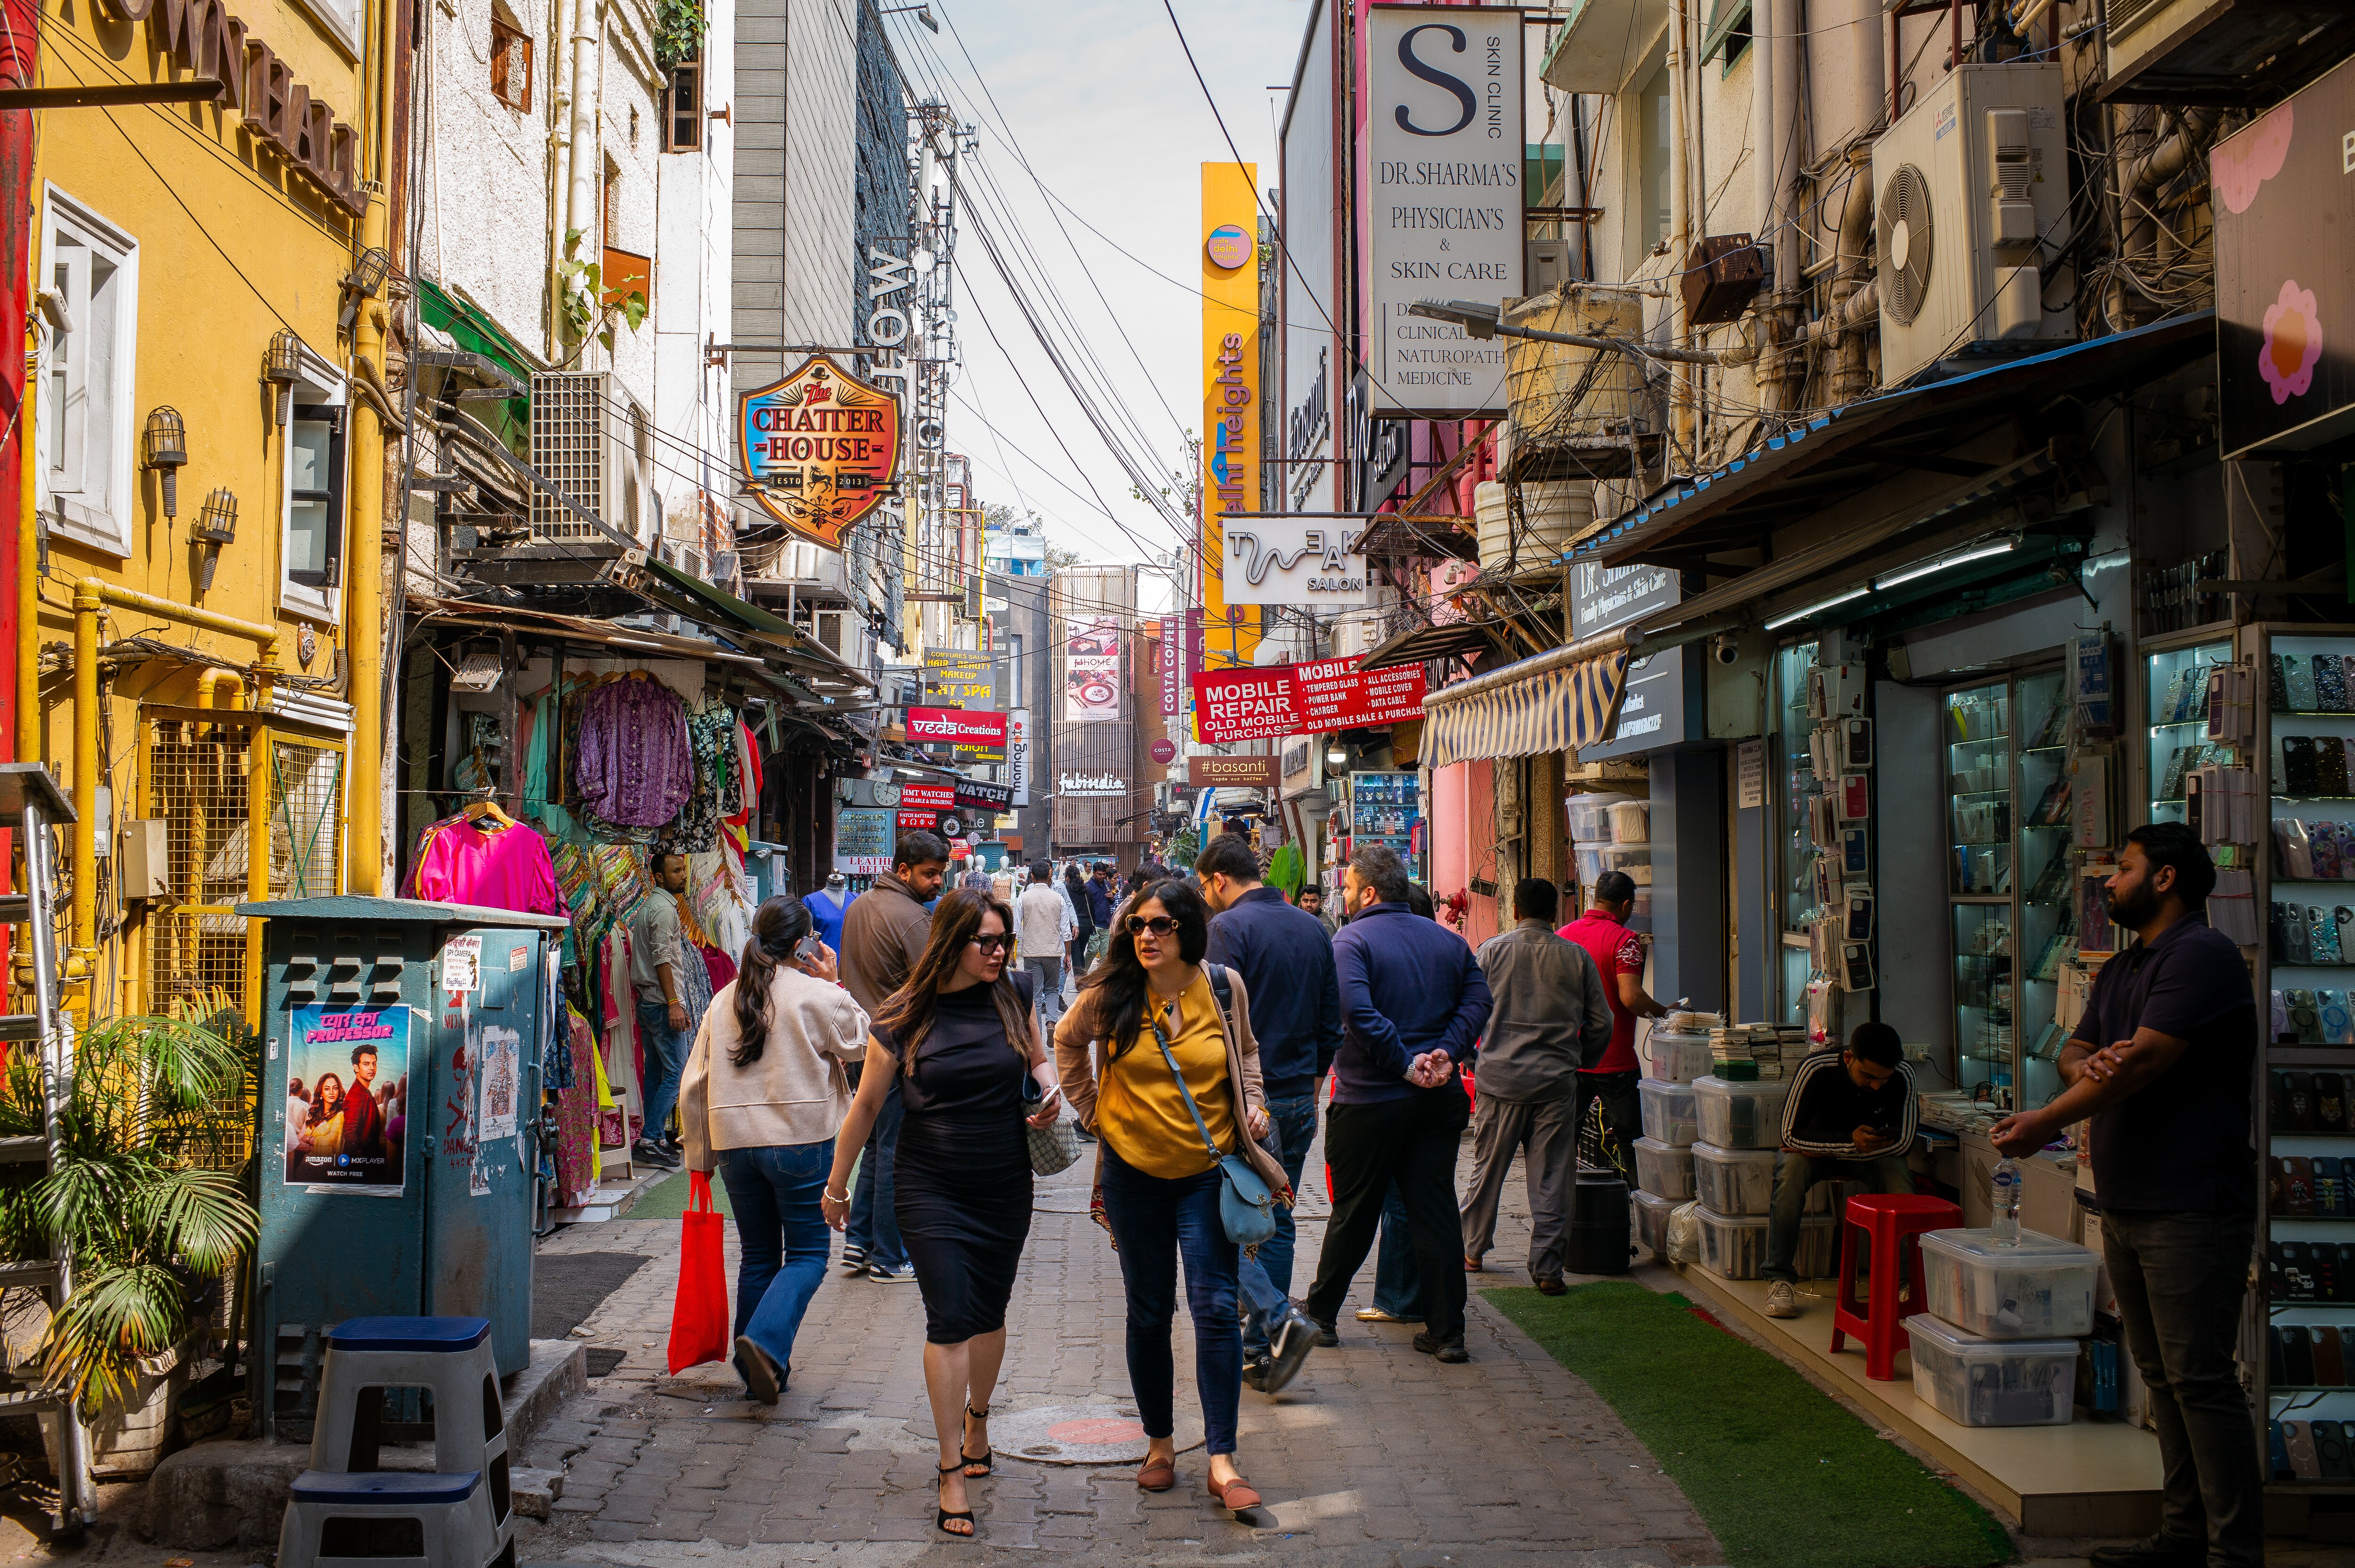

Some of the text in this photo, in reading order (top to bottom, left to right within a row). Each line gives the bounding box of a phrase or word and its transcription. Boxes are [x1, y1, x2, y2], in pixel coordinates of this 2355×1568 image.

[1395, 23, 1477, 137] S
[1486, 36, 1502, 139] SKIN CLINIC
[1380, 162, 1516, 187] DR.SHARMA'S
[1391, 207, 1504, 230] PHYSICIAN'S
[1213, 244, 1238, 253] delhi
[1440, 238, 1451, 252] &
[1391, 262, 1507, 280] SKIN CARE
[1397, 326, 1468, 340] CLINICAL
[1397, 371, 1472, 385] MEDICINE
[803, 380, 833, 405] The
[1217, 333, 1250, 452] heights
[752, 407, 885, 433] CHATTER
[766, 436, 873, 462] HOUSE
[1374, 427, 1402, 483] SALON
[777, 476, 862, 486] ESTD 2013
[1307, 577, 1363, 591] SALON
[1633, 577, 1649, 600] Skin
[1649, 572, 1666, 592] Care
[931, 651, 967, 659] COIFFURES
[2079, 644, 2102, 657] adidas
[927, 659, 991, 671] HAIR BEAUTY
[1164, 620, 1175, 712] COSTA COFFEE
[940, 670, 977, 680] MAKEUP
[1368, 669, 1421, 685] ALL ACCESSORIES
[964, 685, 991, 699] SPA
[1206, 679, 1291, 702] MOBILE
[1306, 678, 1359, 693] TEMPERED GLASS
[1369, 682, 1413, 697] MOBILE COVER
[1308, 691, 1347, 705] POWER BANK
[1371, 695, 1407, 708] DATA CABLE
[1210, 697, 1291, 720] REPAIR
[1310, 705, 1339, 716] CHARGER
[912, 714, 1001, 736] veda Creations
[1204, 712, 1300, 731] OLD MOBILE
[1307, 706, 1426, 731] OLD MOBILE SALE & PURCHASE
[1215, 724, 1292, 742] PURCHASE
[1012, 722, 1027, 793] mamagoto
[1202, 760, 1266, 773] #basanti
[955, 782, 1007, 801] WATCH
[1058, 772, 1126, 796] fabindia
[902, 788, 954, 798] HMT WATCHES
[955, 796, 1005, 810] REPAIRING
[849, 857, 893, 865] LEATHE
[859, 865, 892, 874] BELTS
[319, 1011, 381, 1028] प्यार का
[306, 1025, 393, 1043] PROFESSOR
[2087, 1218, 2097, 1226] DOMO
